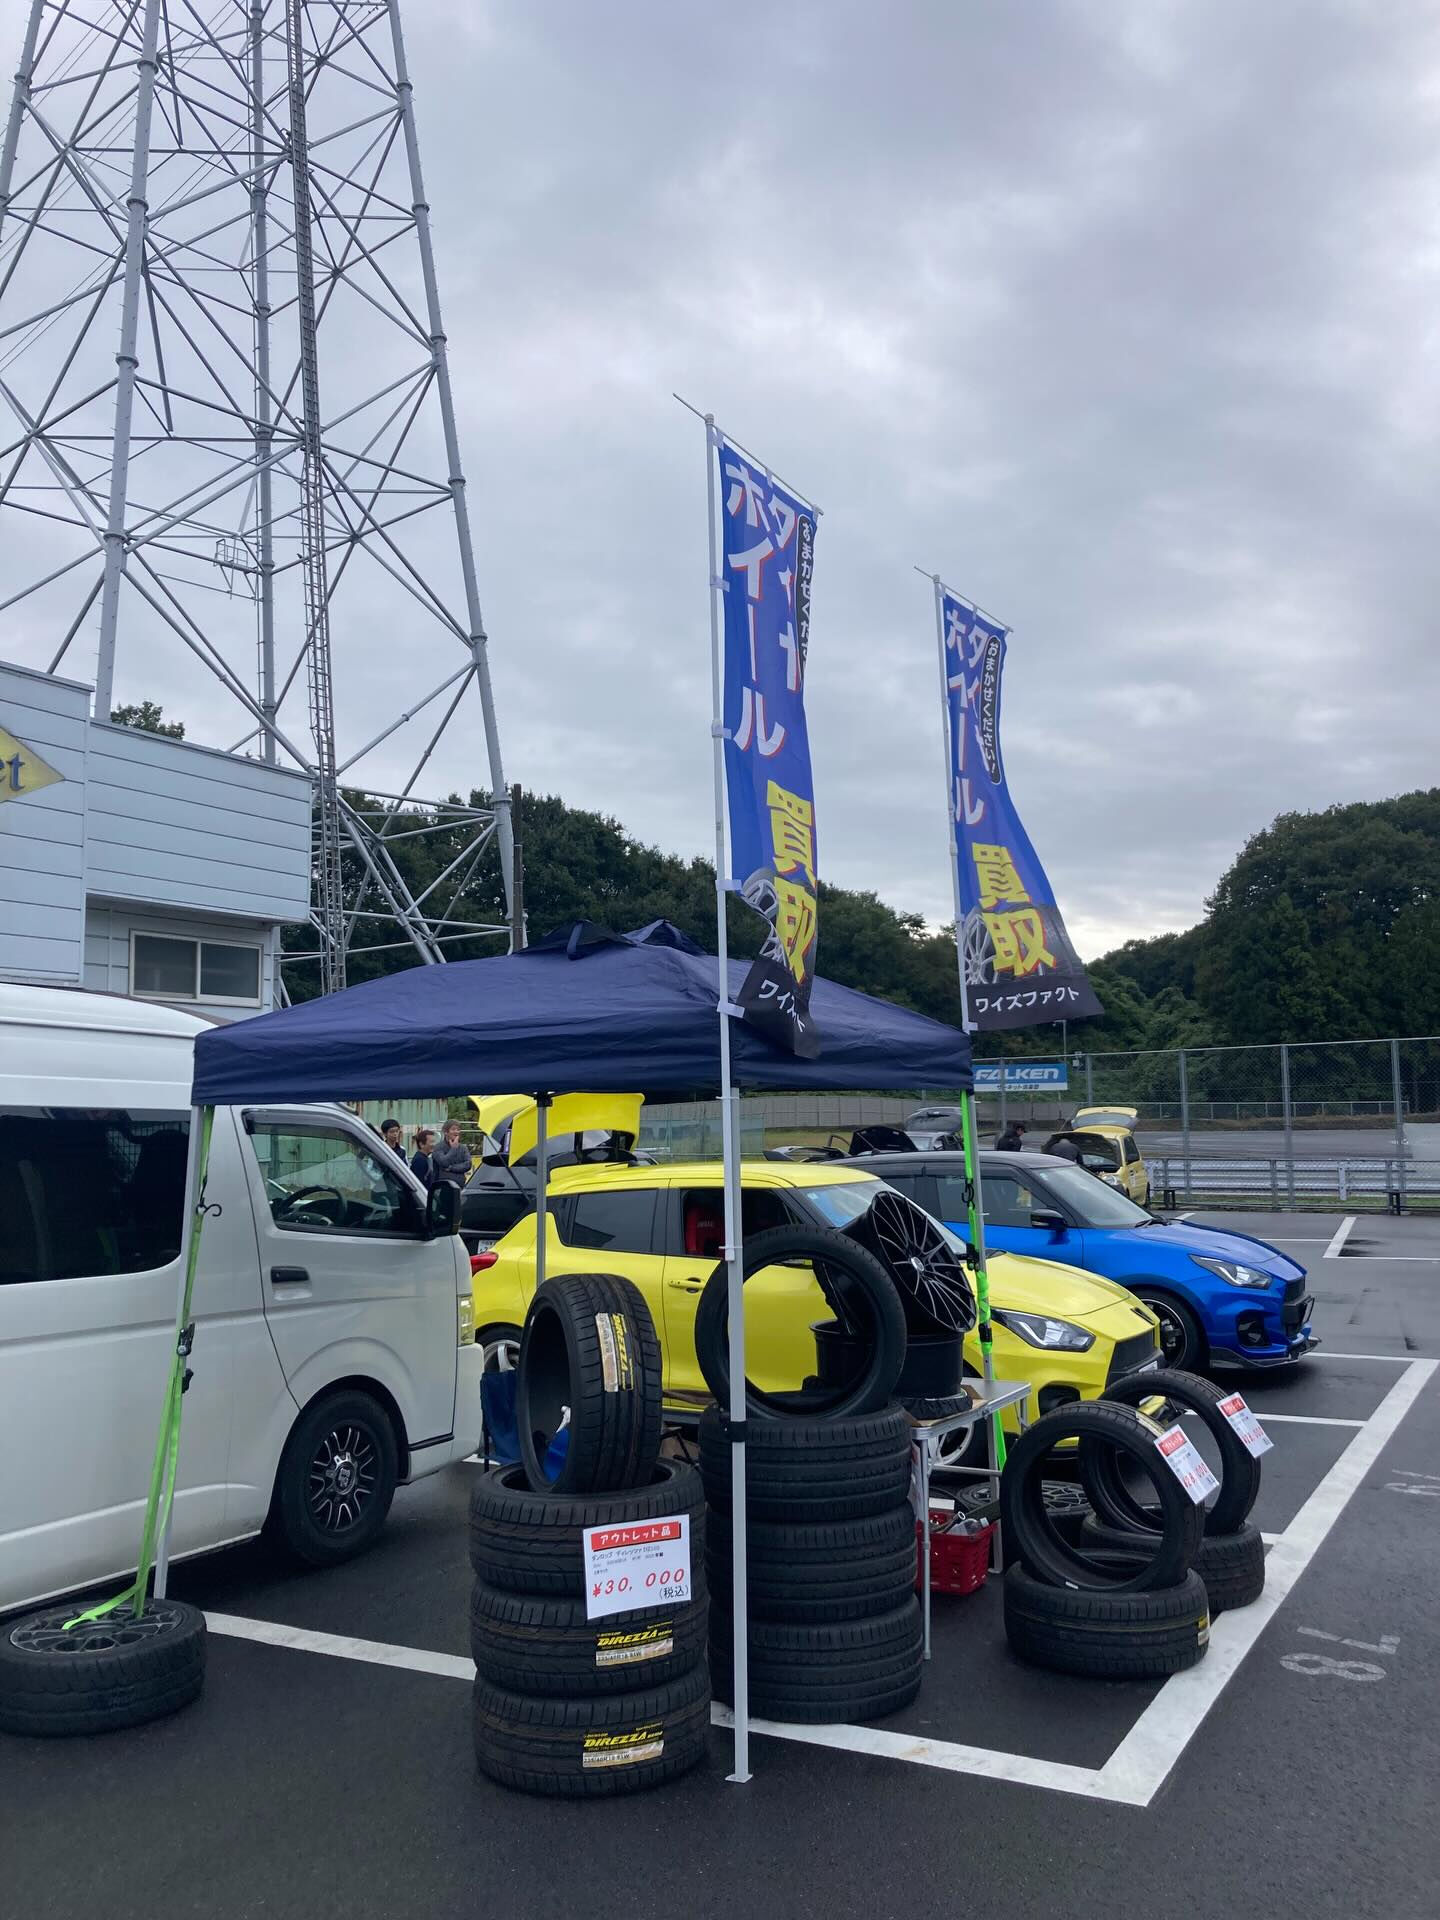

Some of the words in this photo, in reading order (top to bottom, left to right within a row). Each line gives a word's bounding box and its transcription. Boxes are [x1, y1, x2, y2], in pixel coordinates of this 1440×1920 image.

[725, 463, 786, 757] ホイール
[946, 608, 985, 826] ホイール
[968, 842, 1056, 977] 買取
[975, 986, 1080, 1014] ワイズファクト
[975, 1067, 1060, 1081] FALKEN
[600, 1525, 671, 1545] アウトレット品
[597, 1629, 658, 1647] DIREZZA
[583, 1731, 648, 1748] DIREZZA
